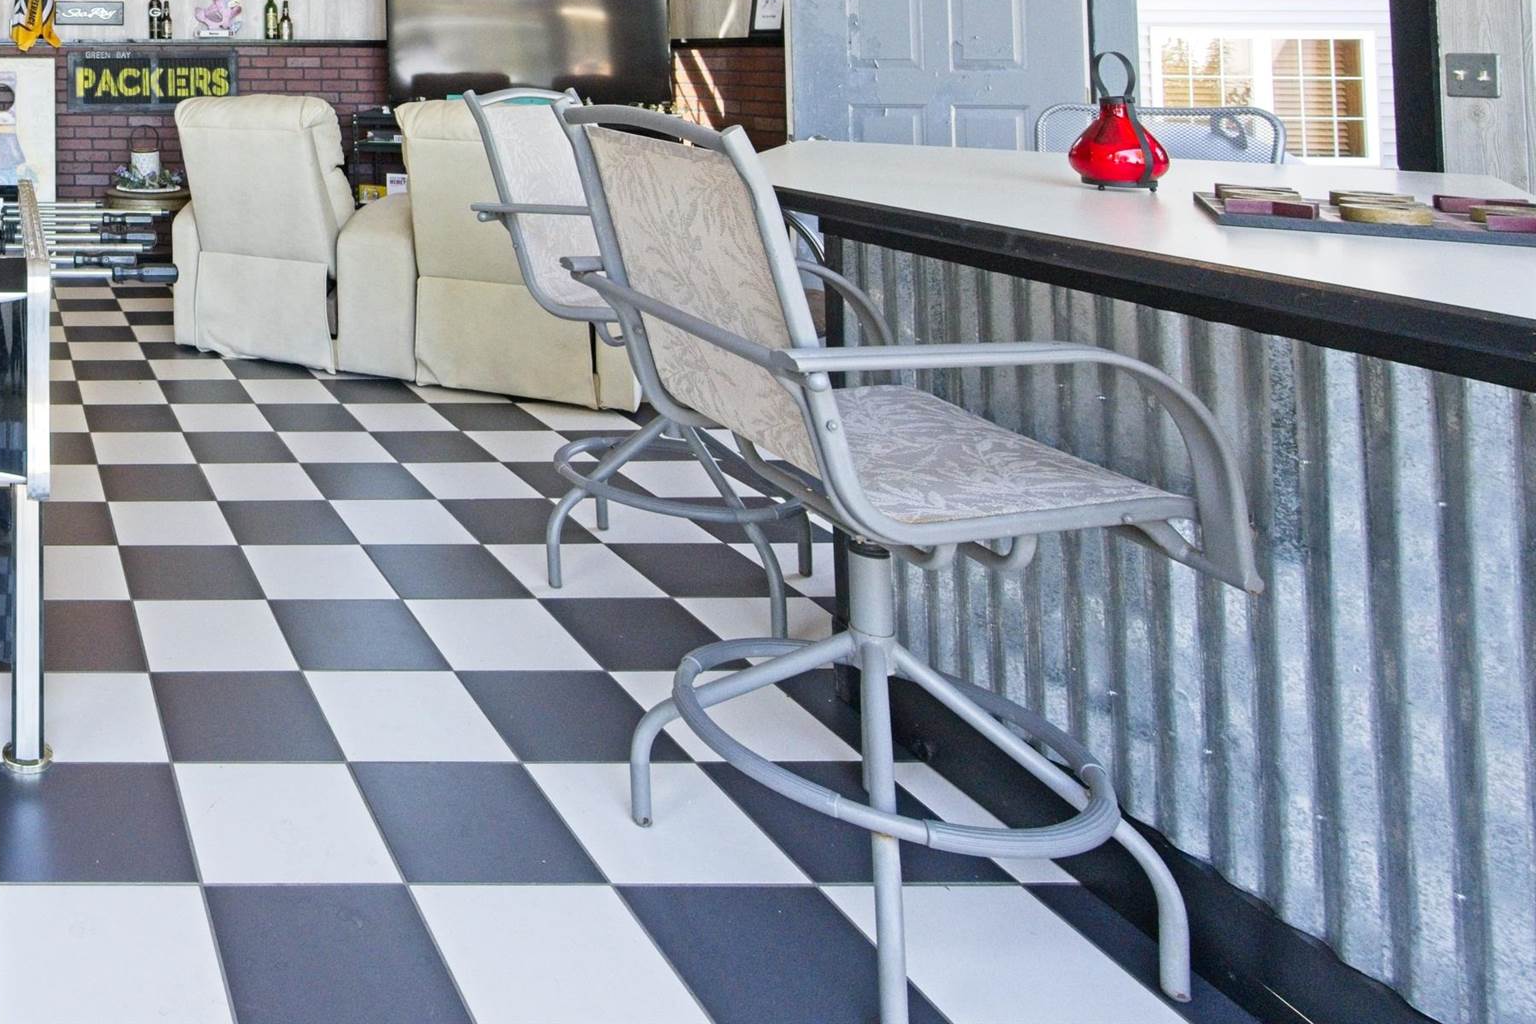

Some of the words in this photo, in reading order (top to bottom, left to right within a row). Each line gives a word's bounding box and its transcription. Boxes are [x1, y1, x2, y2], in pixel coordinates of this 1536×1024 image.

[85, 51, 111, 59] GREEN
[116, 51, 132, 59] BAY
[75, 66, 230, 97] PACKERS
